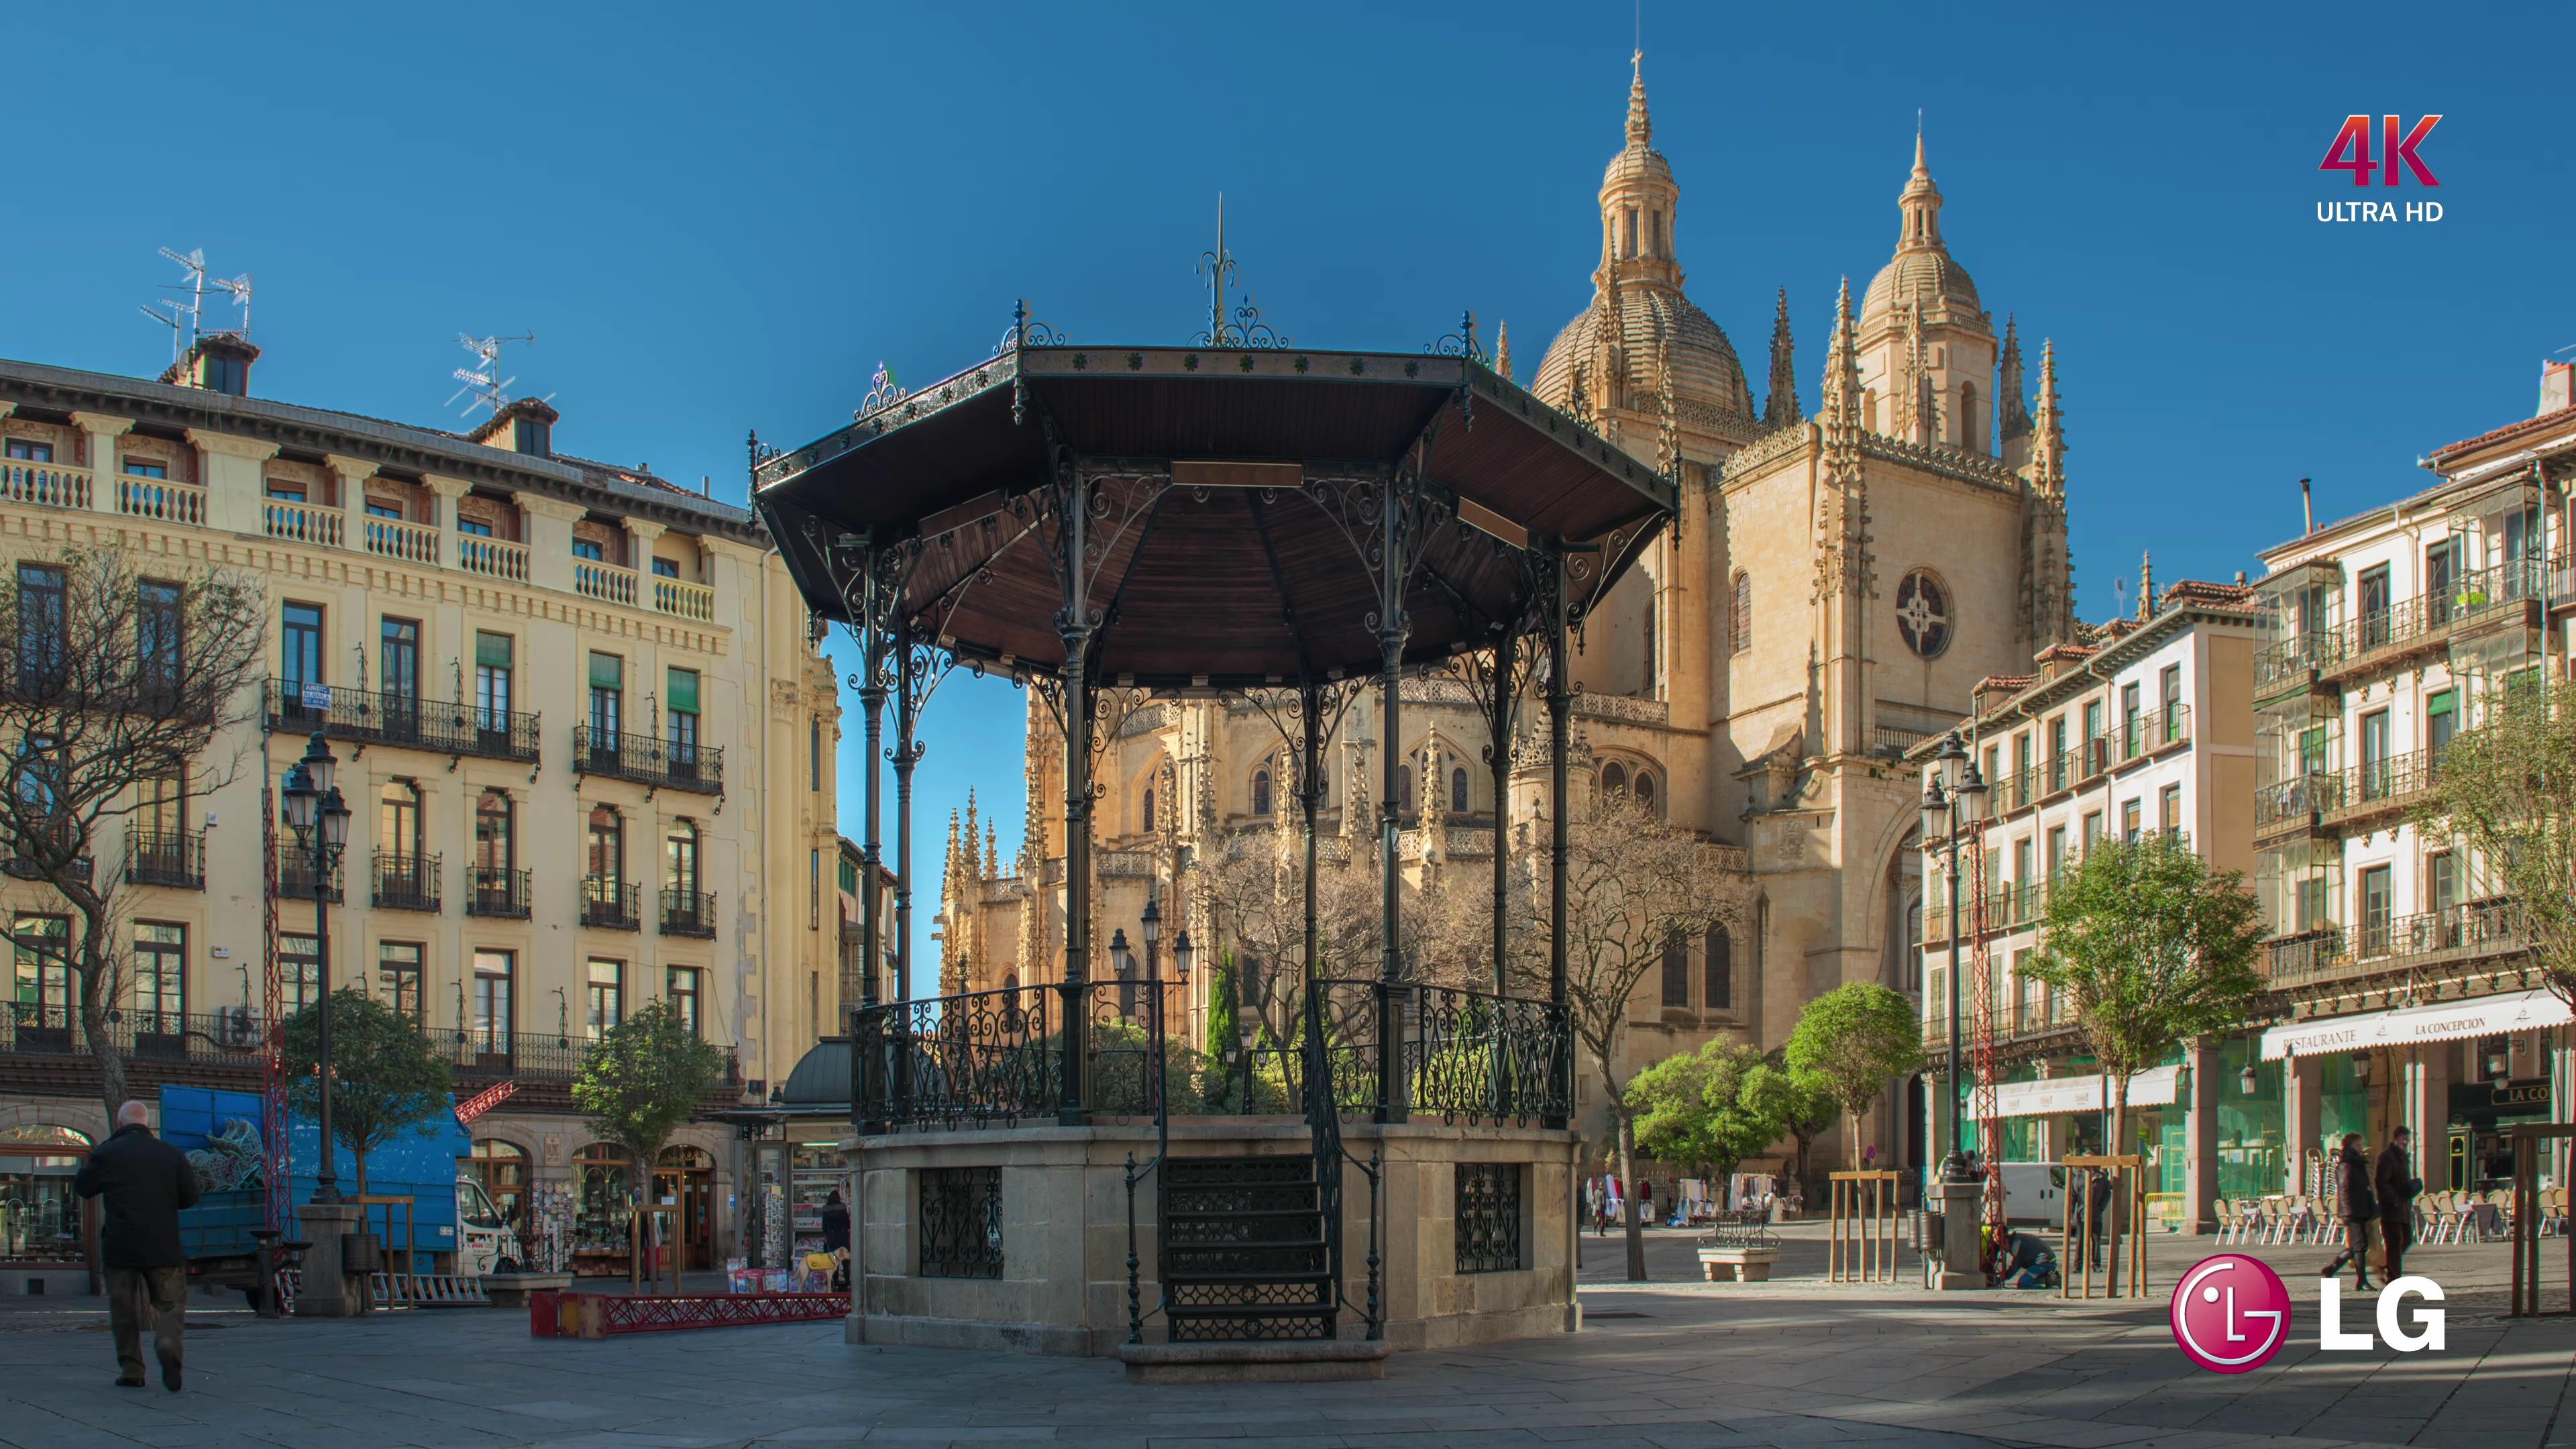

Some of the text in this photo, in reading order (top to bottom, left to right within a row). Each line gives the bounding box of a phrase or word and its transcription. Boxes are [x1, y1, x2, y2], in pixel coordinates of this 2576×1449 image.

[304, 692, 329, 700] ALQUILA
[2415, 1024, 2426, 1035] LA
[2283, 1029, 2357, 1051] RESTAURANTE
[2509, 1087, 2551, 1102] LA CO
